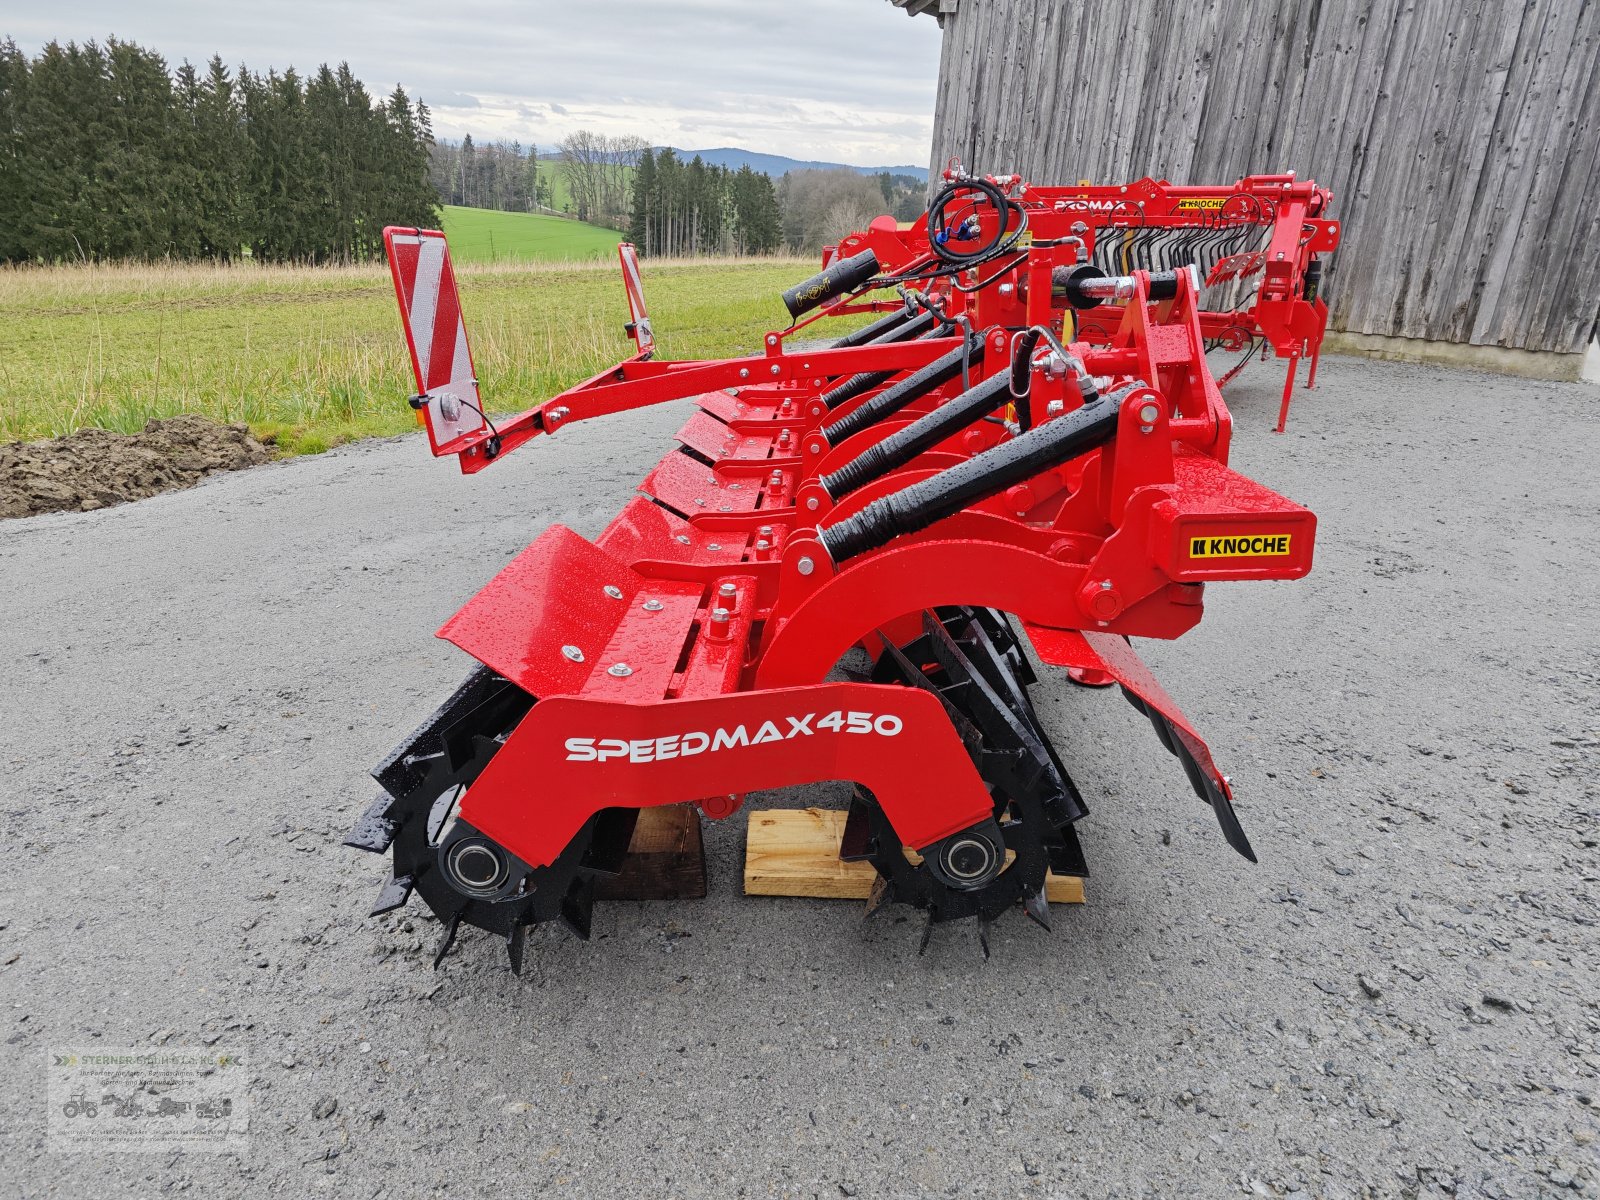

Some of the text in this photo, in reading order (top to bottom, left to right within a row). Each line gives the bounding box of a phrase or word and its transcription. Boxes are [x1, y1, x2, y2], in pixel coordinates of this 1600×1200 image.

[1054, 201, 1127, 210] PROMAX
[1187, 200, 1224, 208] KNOCHE
[1210, 537, 1288, 555] KNOCHE
